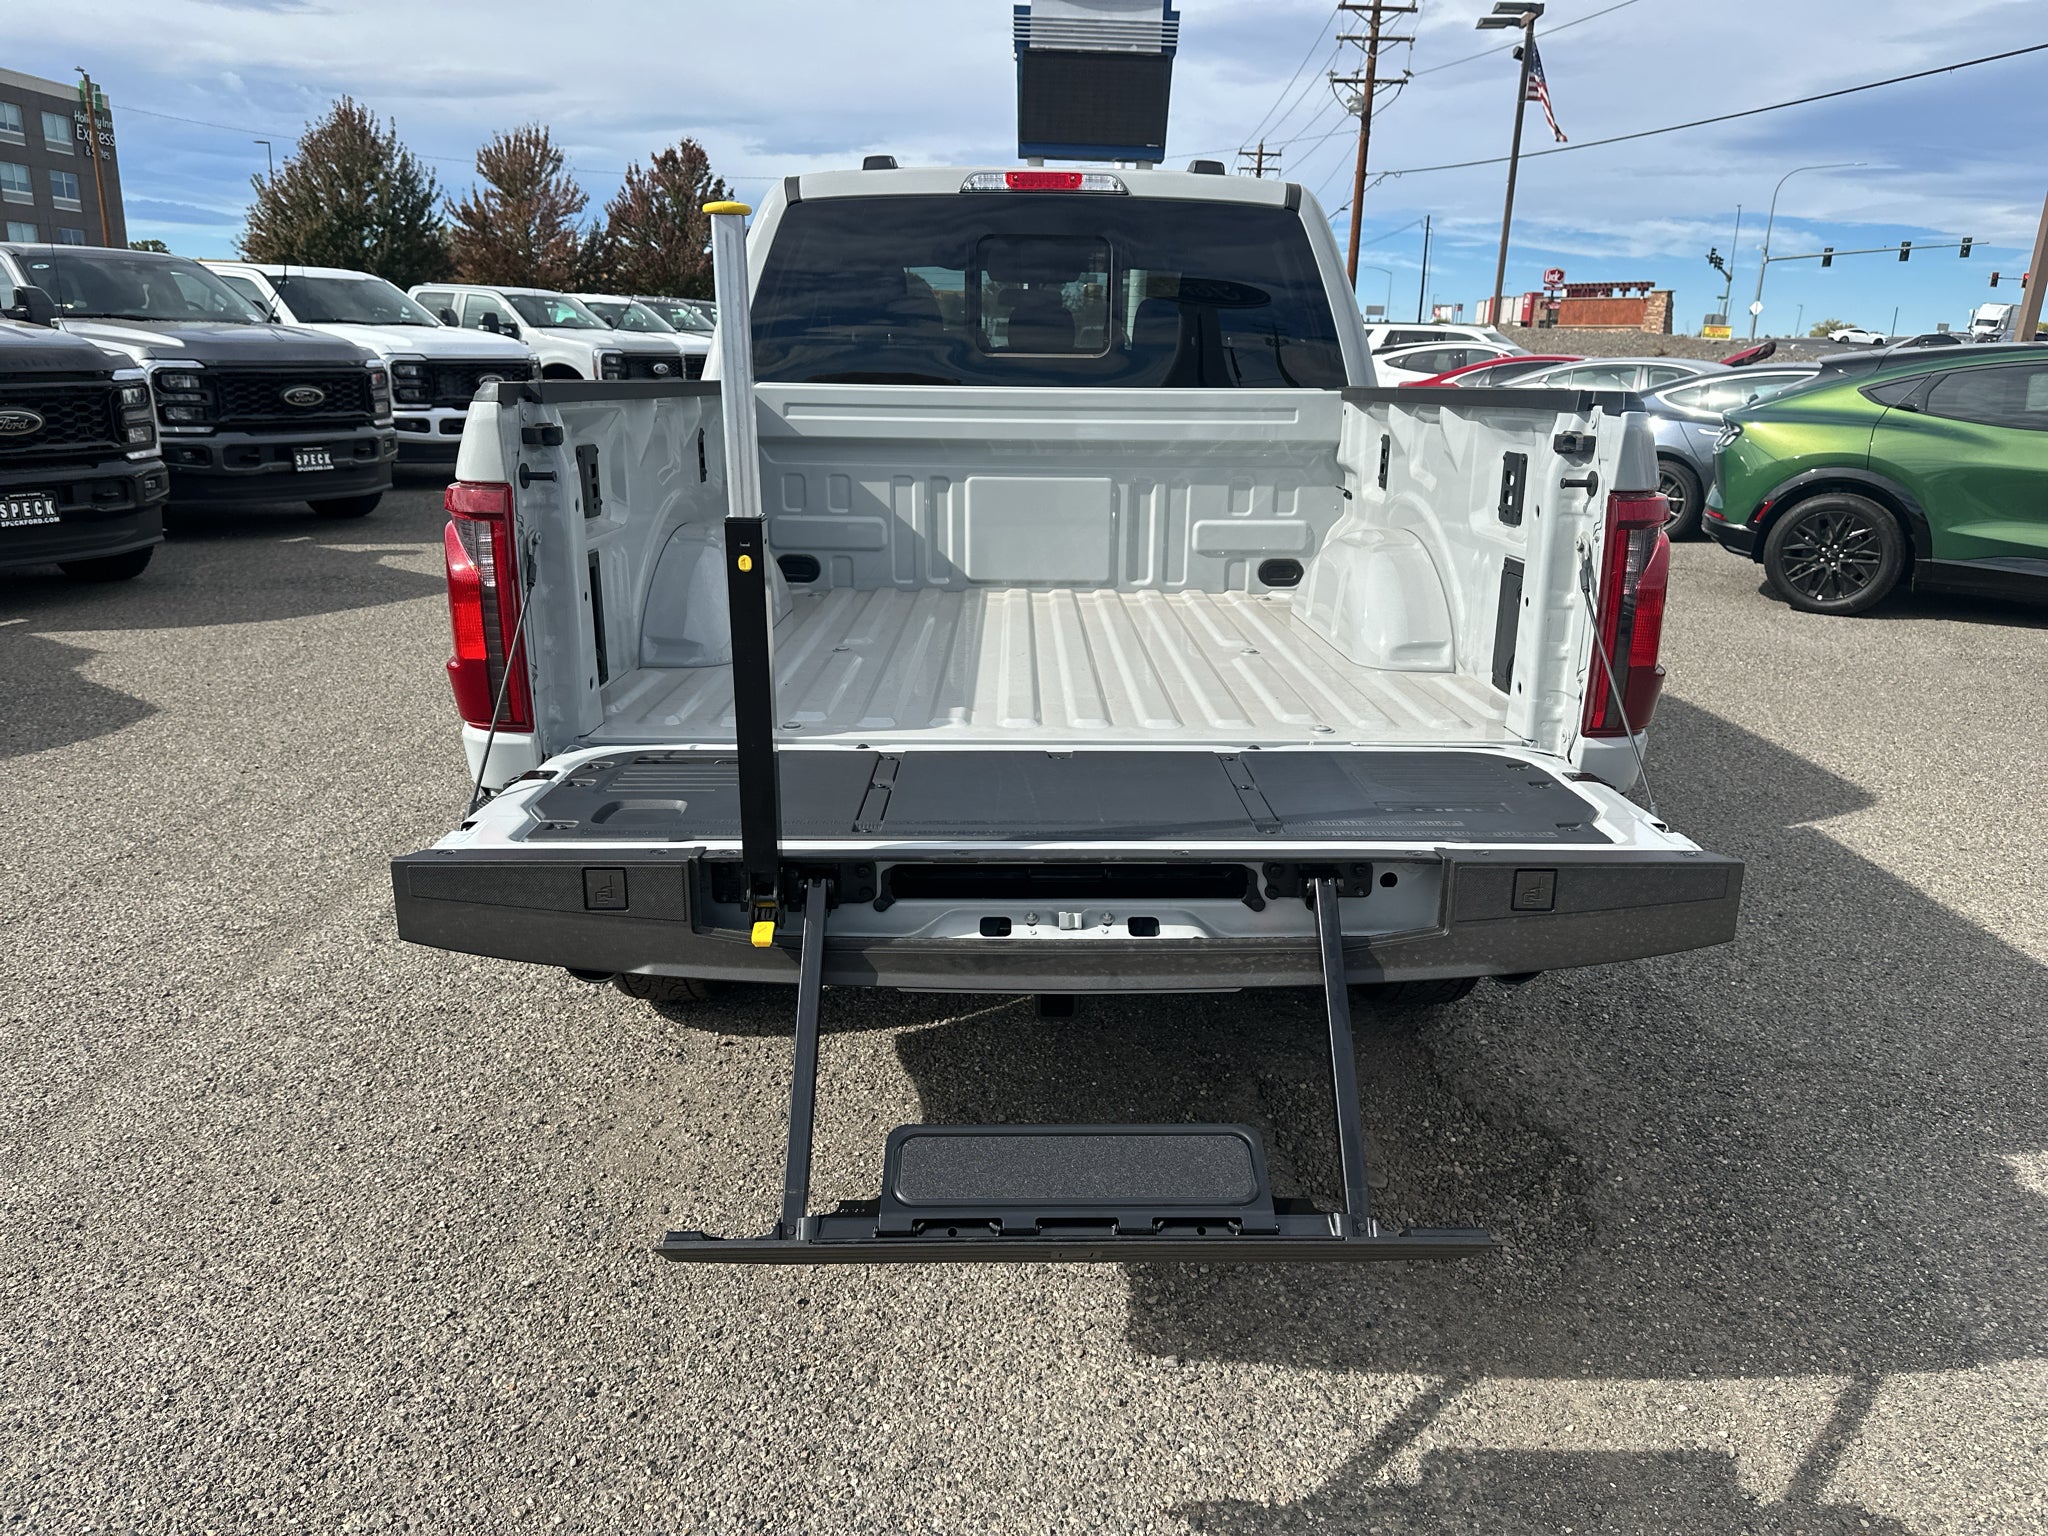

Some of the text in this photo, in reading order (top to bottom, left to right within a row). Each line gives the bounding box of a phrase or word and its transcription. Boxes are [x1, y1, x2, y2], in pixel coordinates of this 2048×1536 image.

[74, 109, 102, 129] Holiy
[76, 123, 115, 147] Expess
[296, 453, 331, 466] SPECK
[0, 500, 55, 518] SPECK
